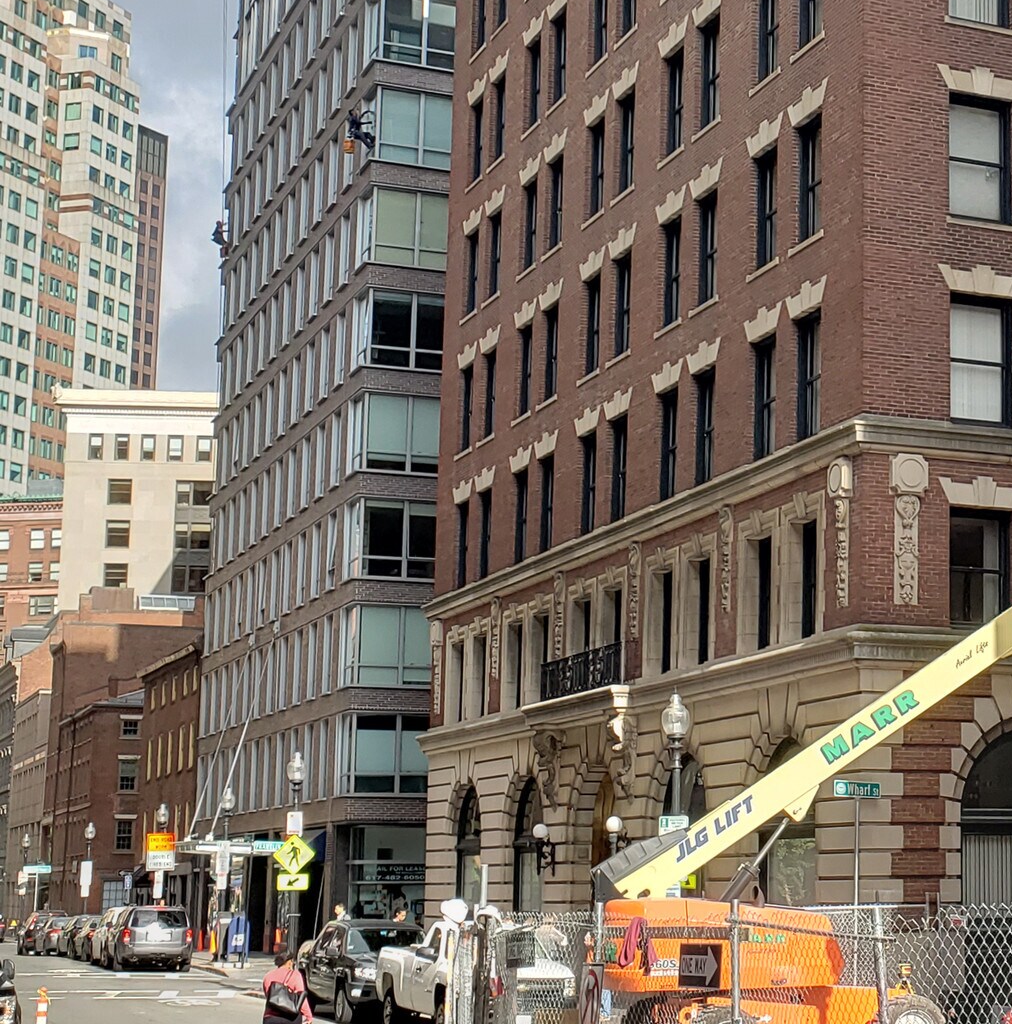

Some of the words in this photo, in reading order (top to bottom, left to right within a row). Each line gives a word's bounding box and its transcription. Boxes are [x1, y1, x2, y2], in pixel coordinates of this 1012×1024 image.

[820, 690, 920, 765] MARR
[848, 783, 871, 796] Wharf
[676, 826, 709, 863] JLG
[713, 794, 753, 836] LIFT
[681, 957, 693, 975] ONE
[694, 956, 707, 975] WAY
